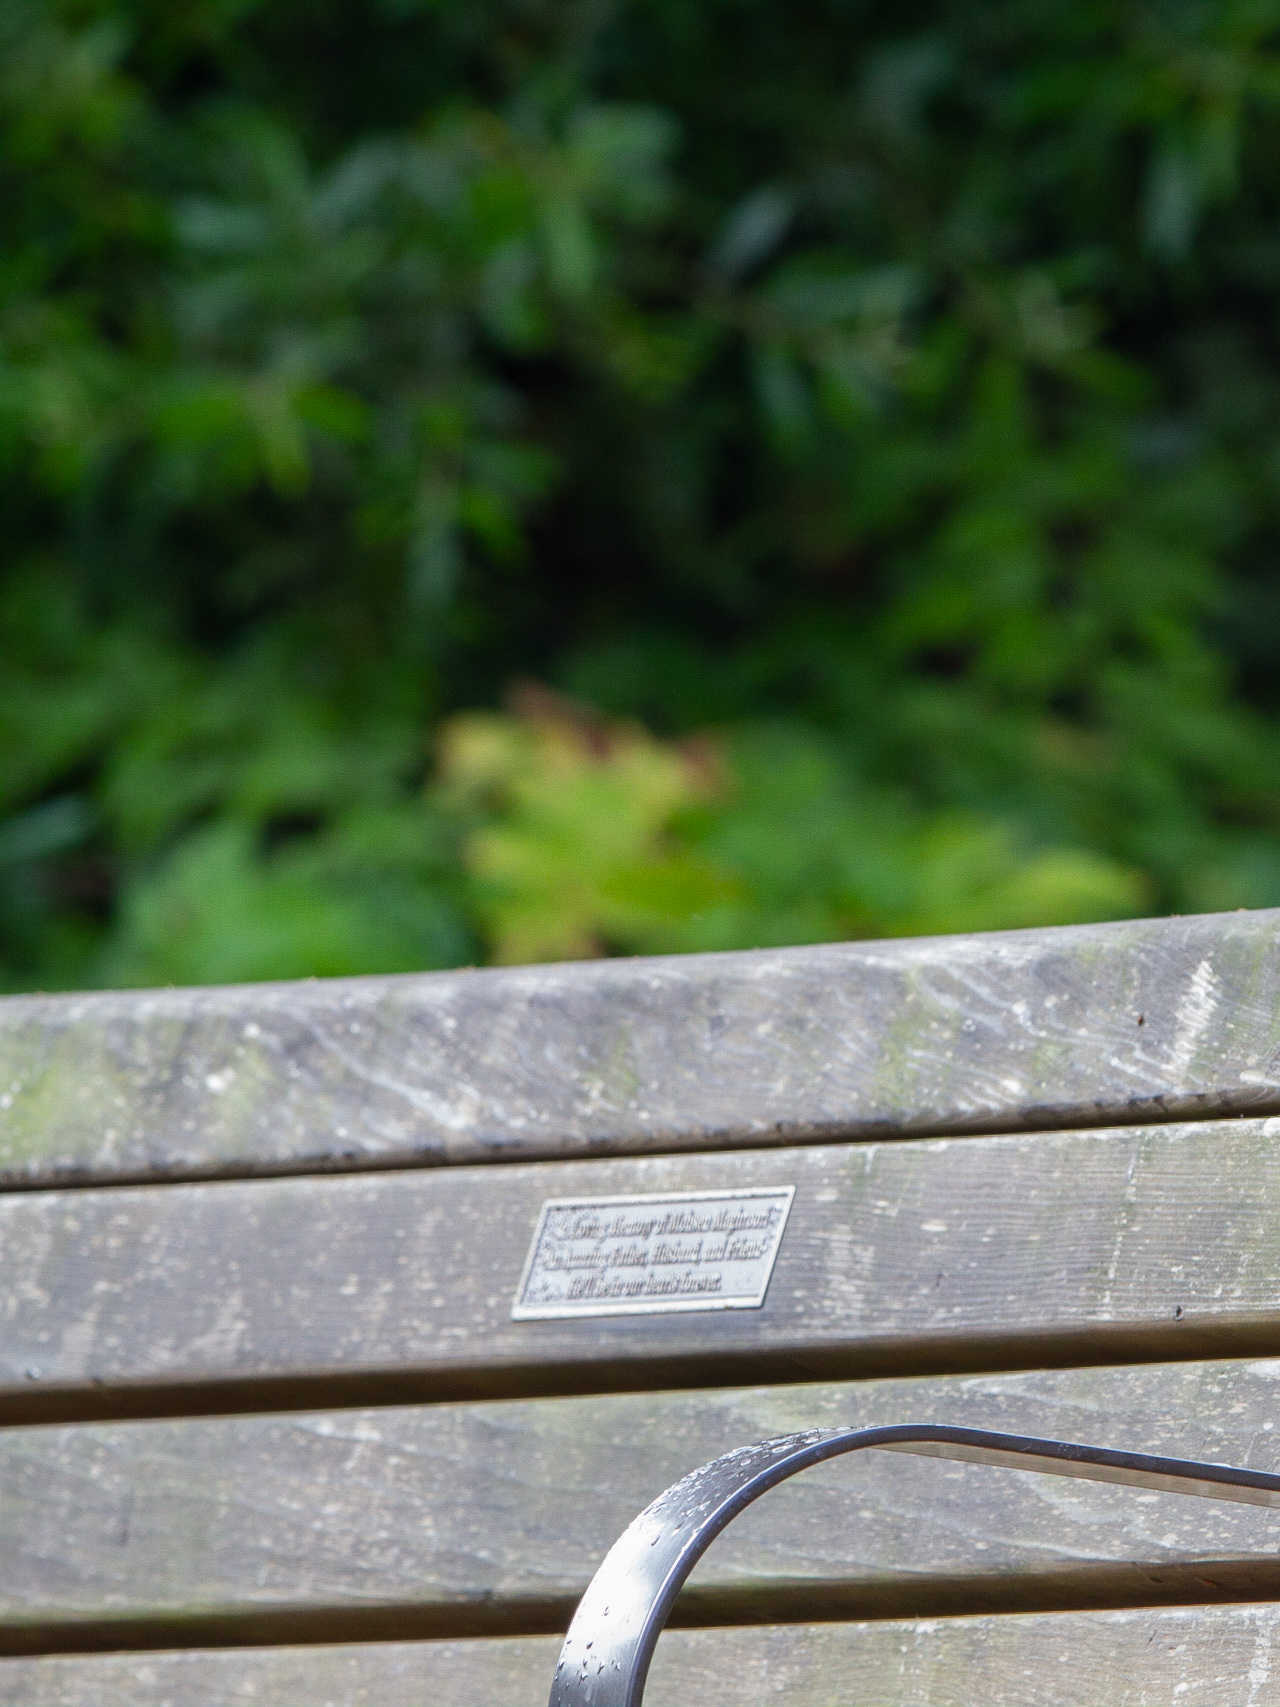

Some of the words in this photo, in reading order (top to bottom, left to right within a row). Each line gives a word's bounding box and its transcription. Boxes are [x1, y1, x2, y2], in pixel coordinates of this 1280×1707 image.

[572, 1214, 608, 1242] Loving
[609, 1214, 652, 1239] Memory
[653, 1213, 670, 1235] of
[564, 1246, 608, 1272] Amazing
[704, 1239, 729, 1263] and
[726, 1237, 766, 1261] Friend
[567, 1276, 595, 1299] He'll
[594, 1275, 609, 1298] be
[609, 1275, 624, 1297] in
[623, 1278, 645, 1297] our
[644, 1271, 680, 1295] hearts
